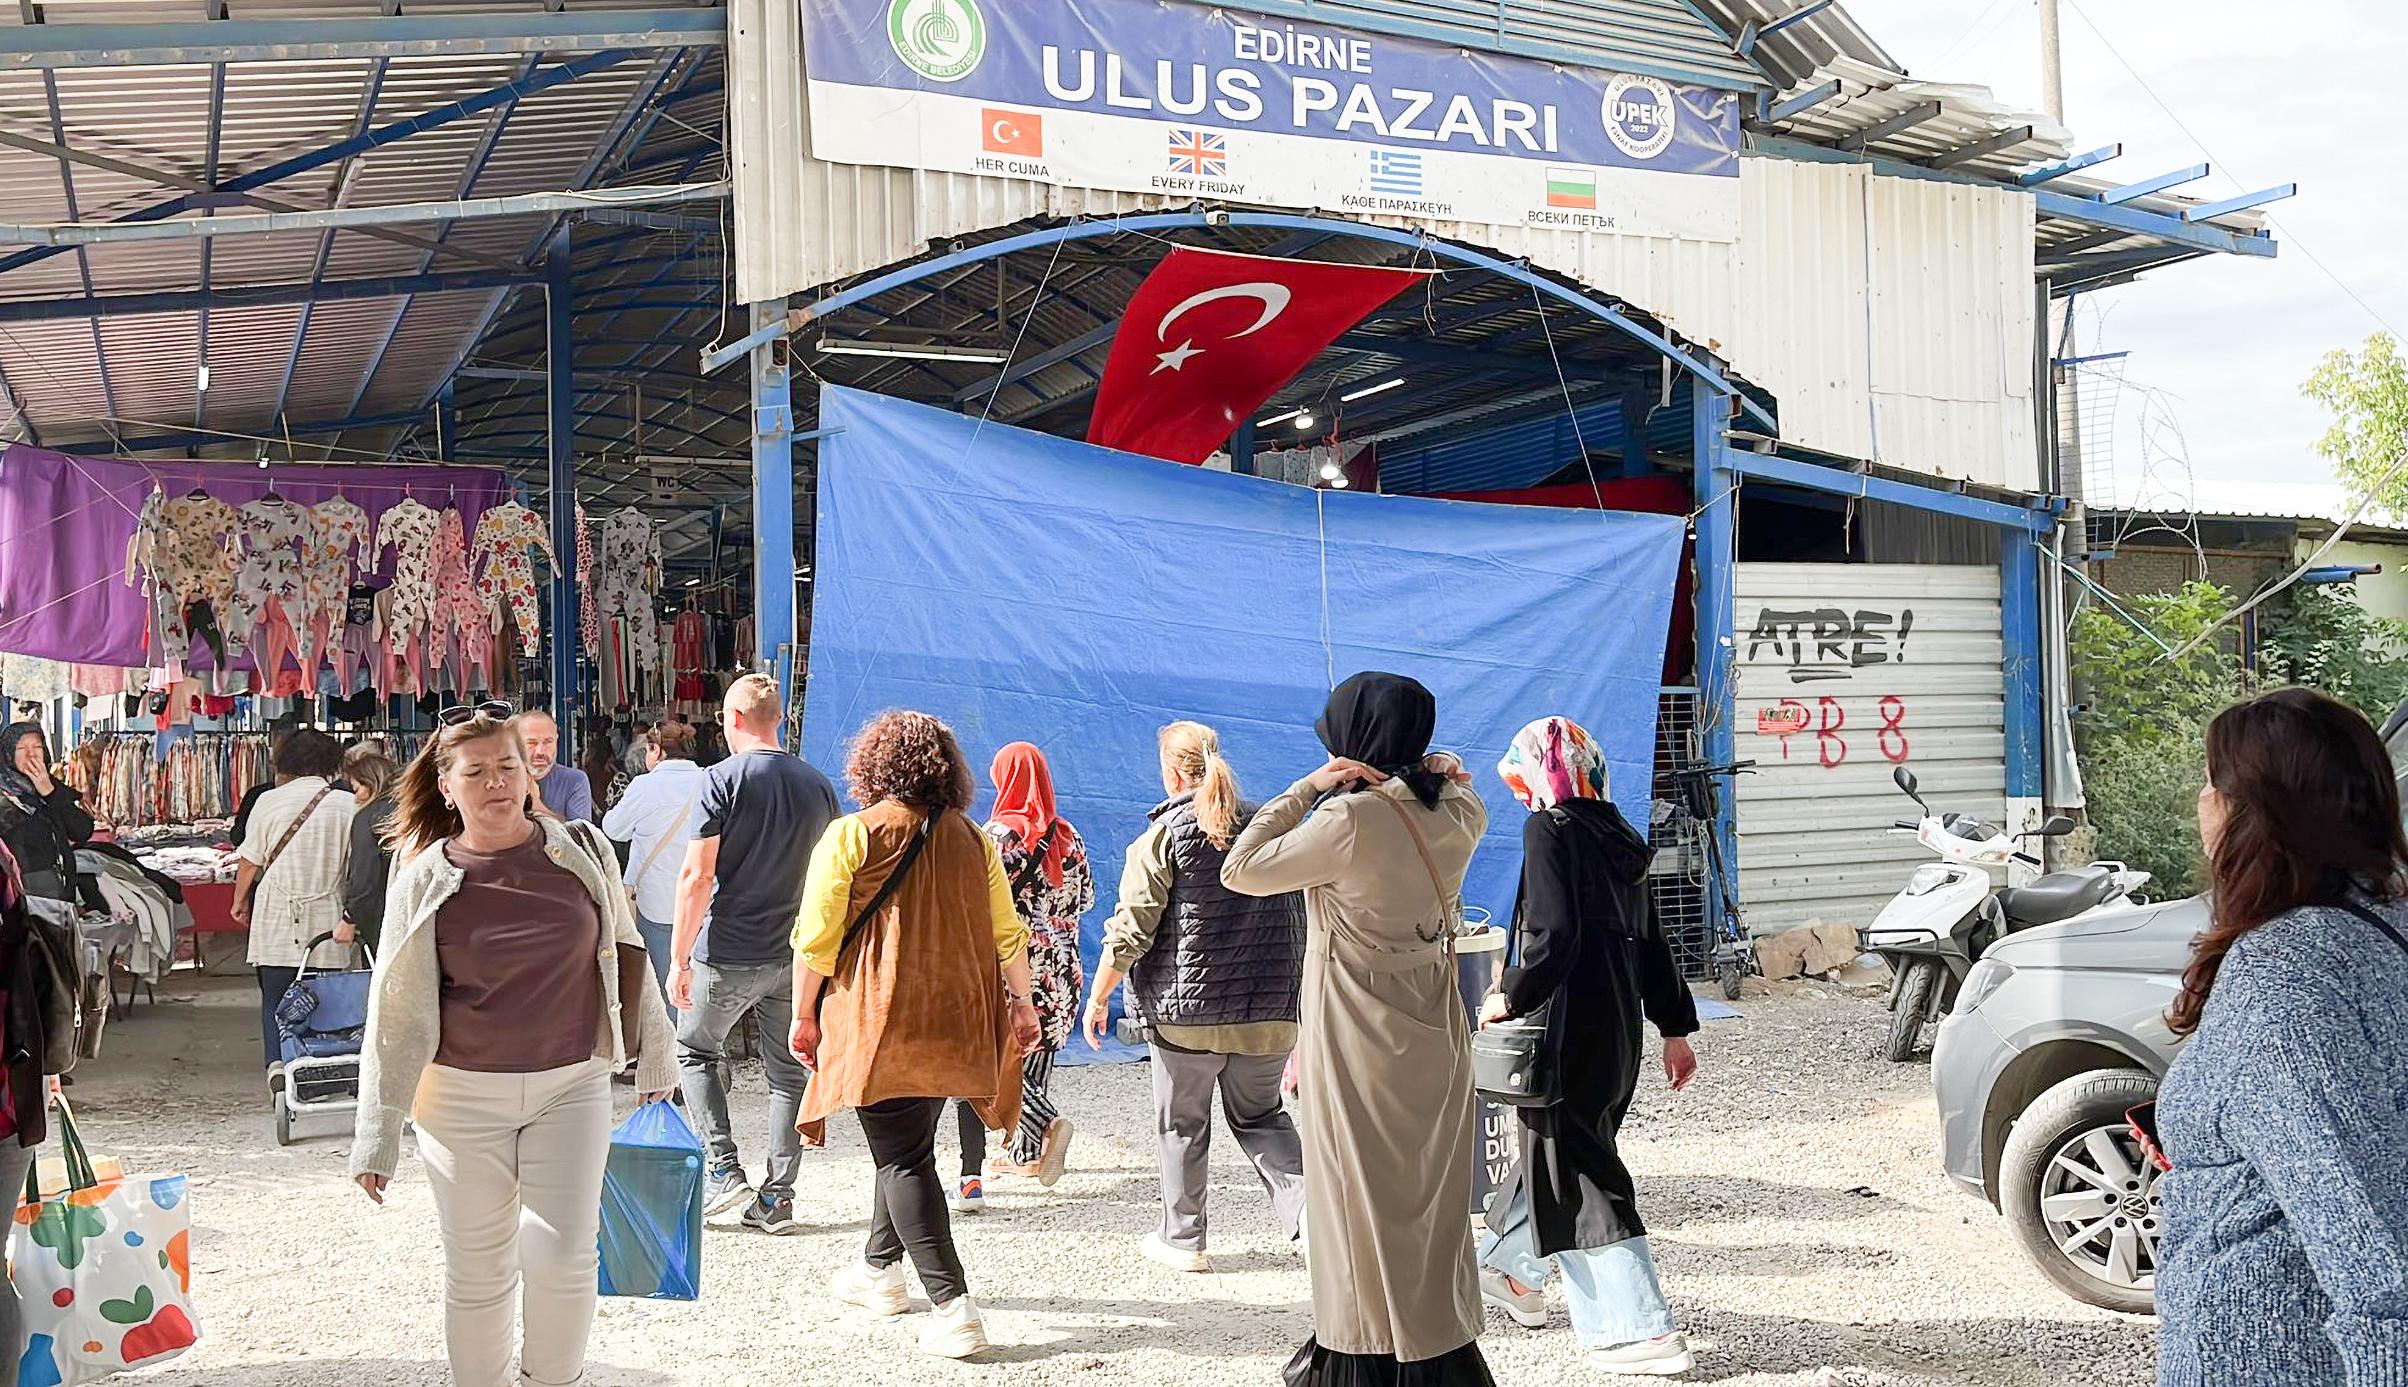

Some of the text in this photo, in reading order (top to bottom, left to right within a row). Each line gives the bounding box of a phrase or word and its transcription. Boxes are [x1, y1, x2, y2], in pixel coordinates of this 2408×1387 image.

[1234, 24, 1373, 74] EDİRNE
[1042, 45, 1559, 153] ULUS PAZARI
[1611, 99, 1668, 127] UPEK
[1630, 124, 1649, 133] 2022
[976, 157, 1050, 177] HER CUMA
[1152, 175, 1245, 195] EVERY FRIDAY
[1528, 210, 1615, 228] ВСЕКИ ПЕТЪК
[656, 476, 675, 488] WC
[1748, 608, 1914, 667] ATRE!
[1877, 694, 1909, 764] 8
